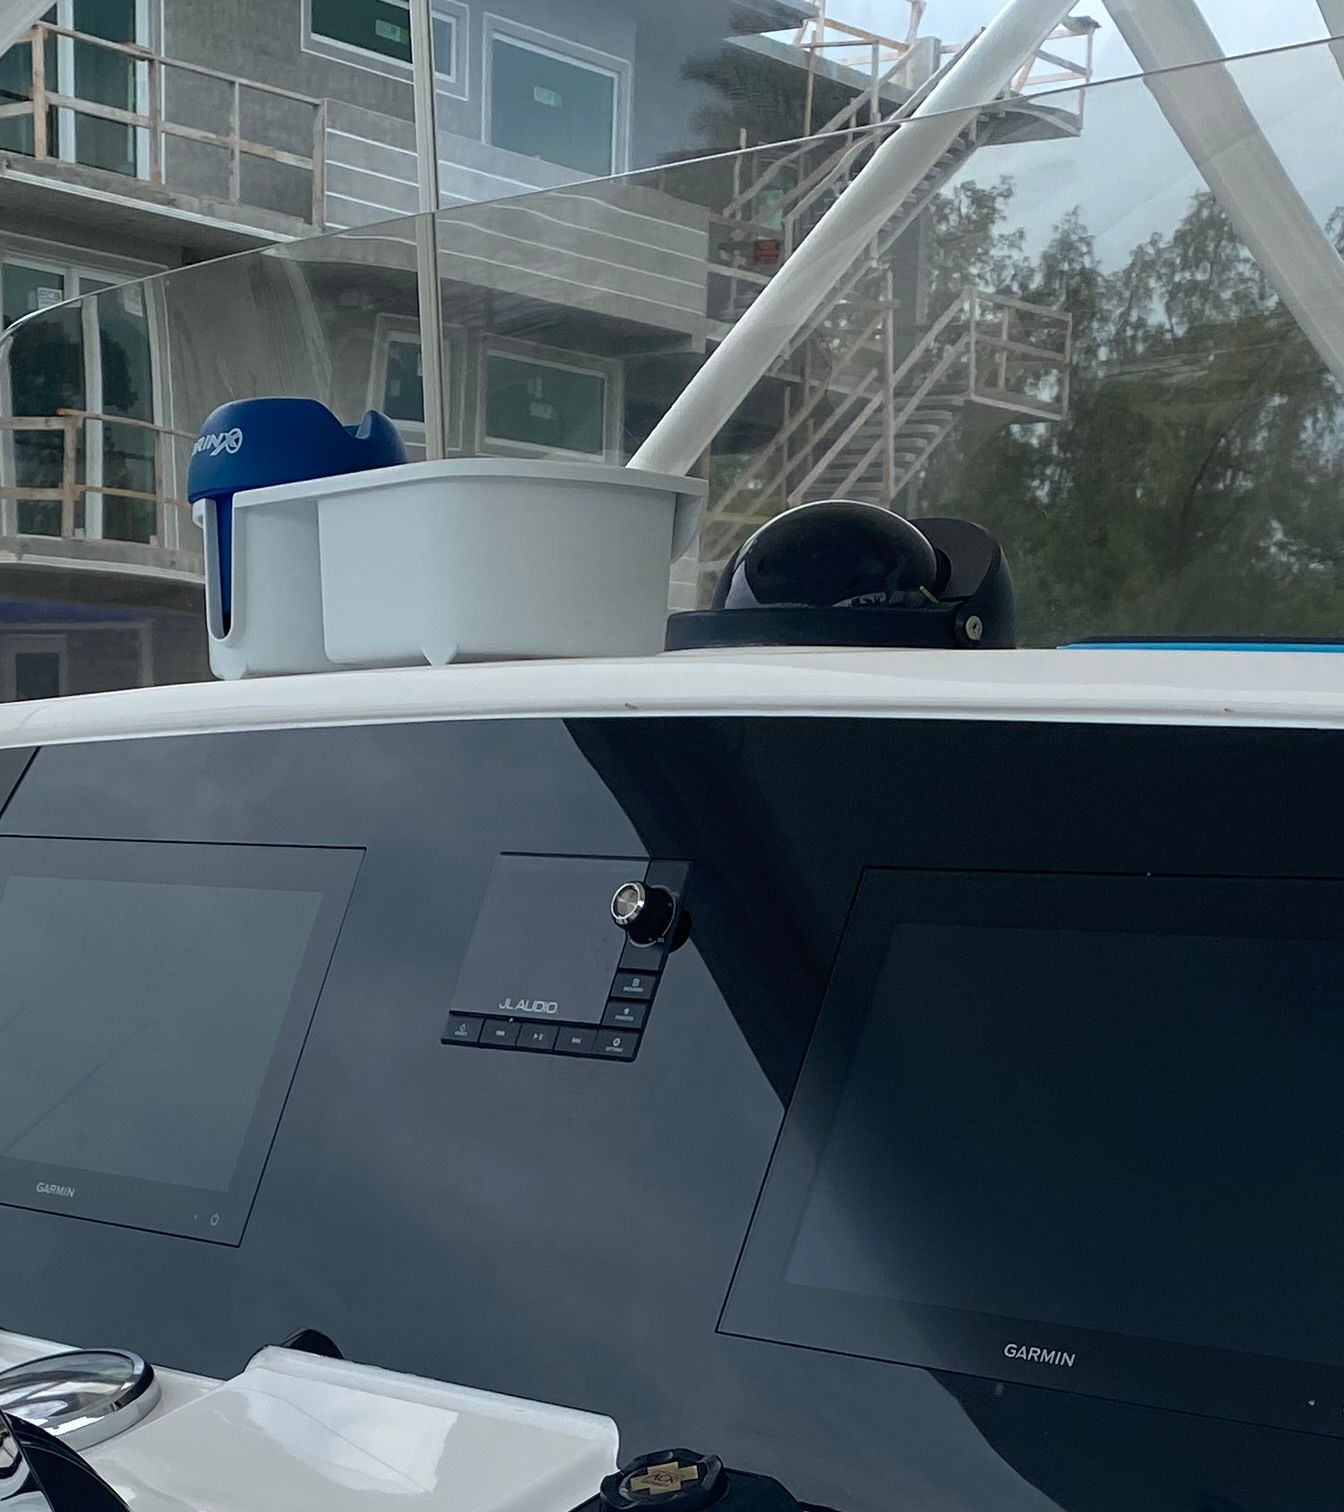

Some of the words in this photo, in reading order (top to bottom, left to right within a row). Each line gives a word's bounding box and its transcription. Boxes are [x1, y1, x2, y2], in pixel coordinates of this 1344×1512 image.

[499, 998, 514, 1010] JL
[516, 999, 558, 1014] AUDIO
[36, 1182, 75, 1198] GARMIN
[1003, 1343, 1076, 1368] GARMIN
